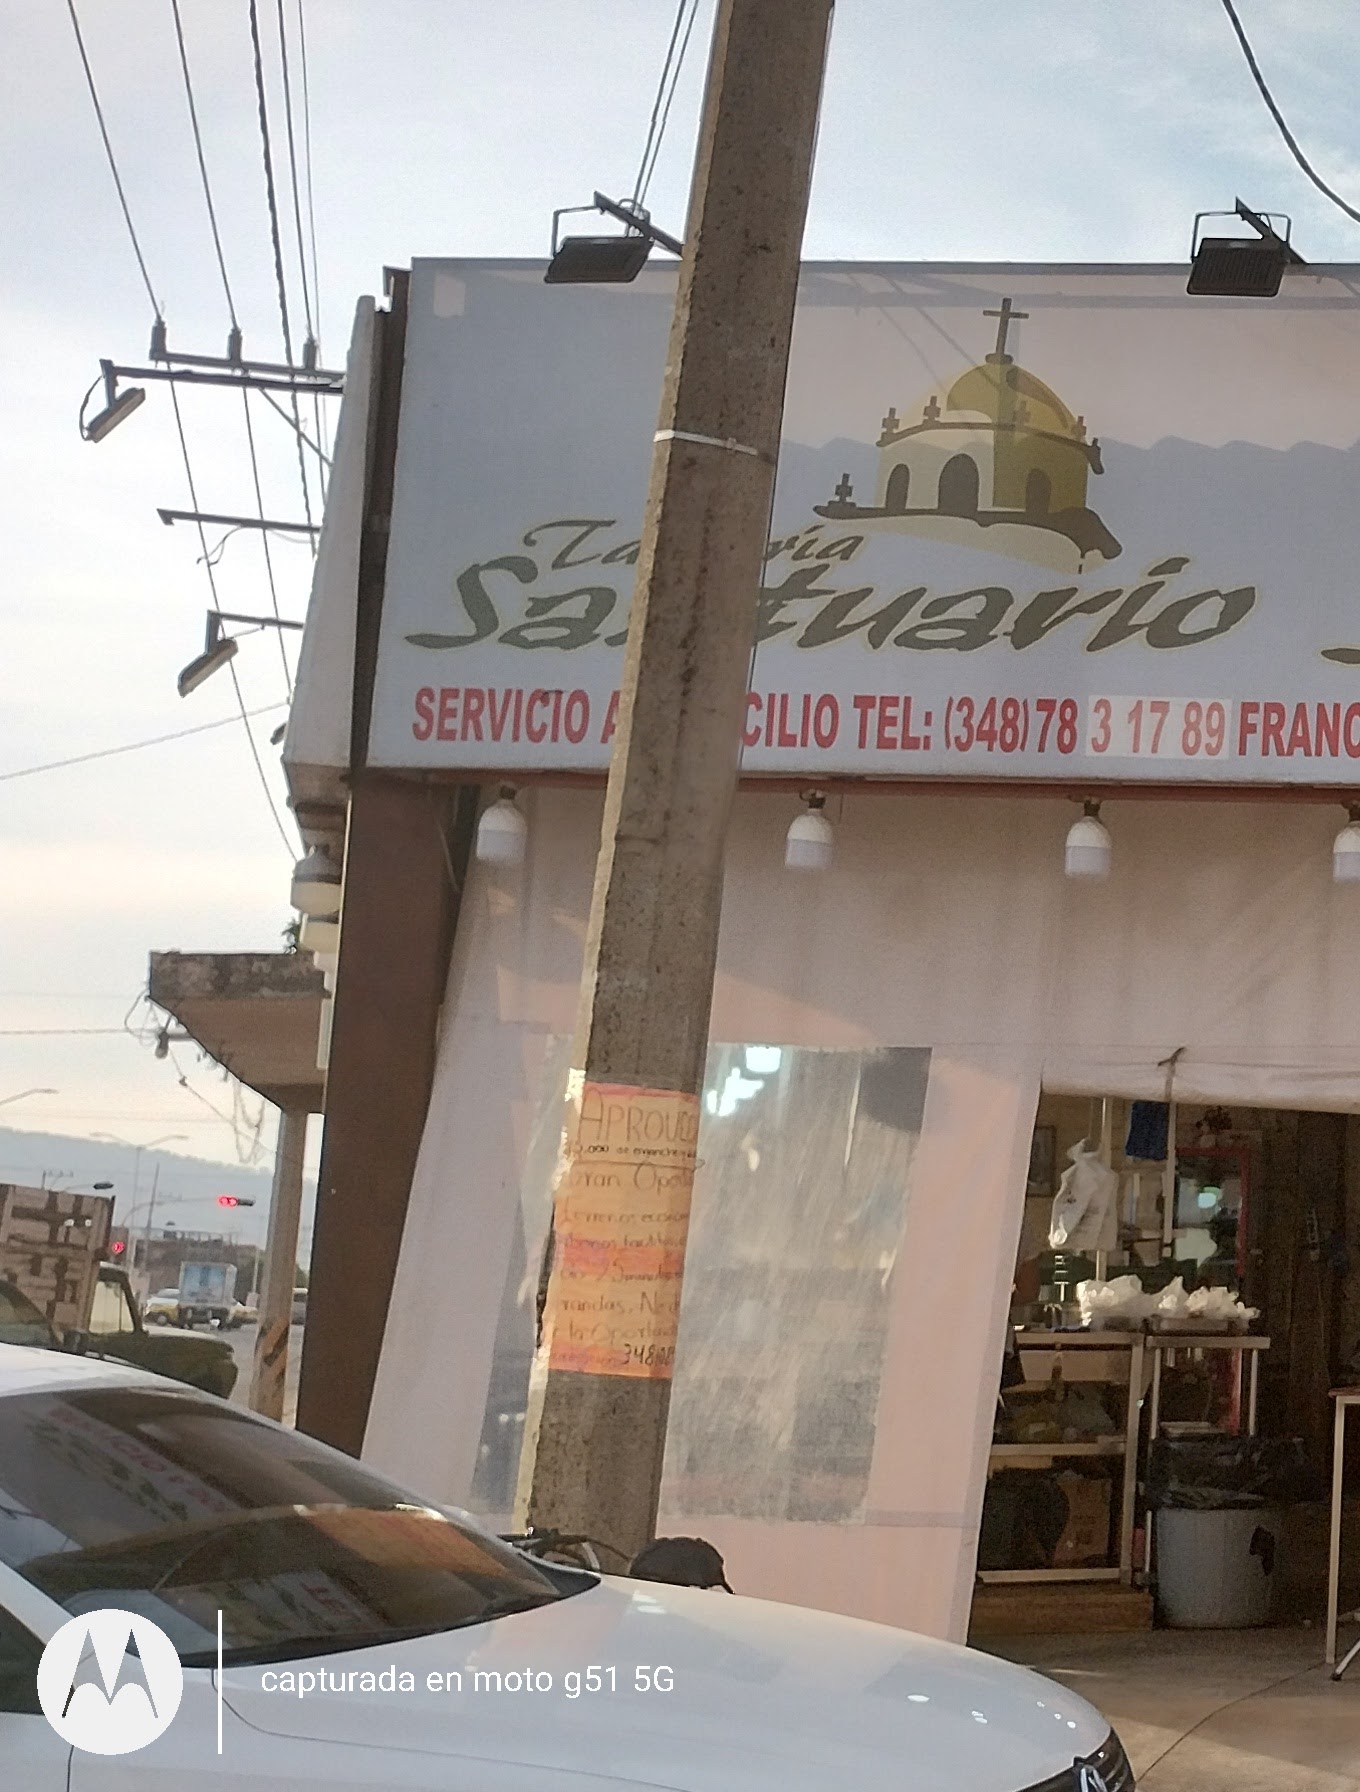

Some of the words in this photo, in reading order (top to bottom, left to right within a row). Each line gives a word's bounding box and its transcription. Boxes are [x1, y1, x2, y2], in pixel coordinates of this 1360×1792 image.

[404, 556, 1256, 652] Satuario
[412, 686, 590, 744] SERVICIO
[853, 694, 933, 751] TEL:
[1091, 699, 1112, 753] 3
[1127, 700, 1170, 754] 17
[1181, 701, 1226, 757] 89
